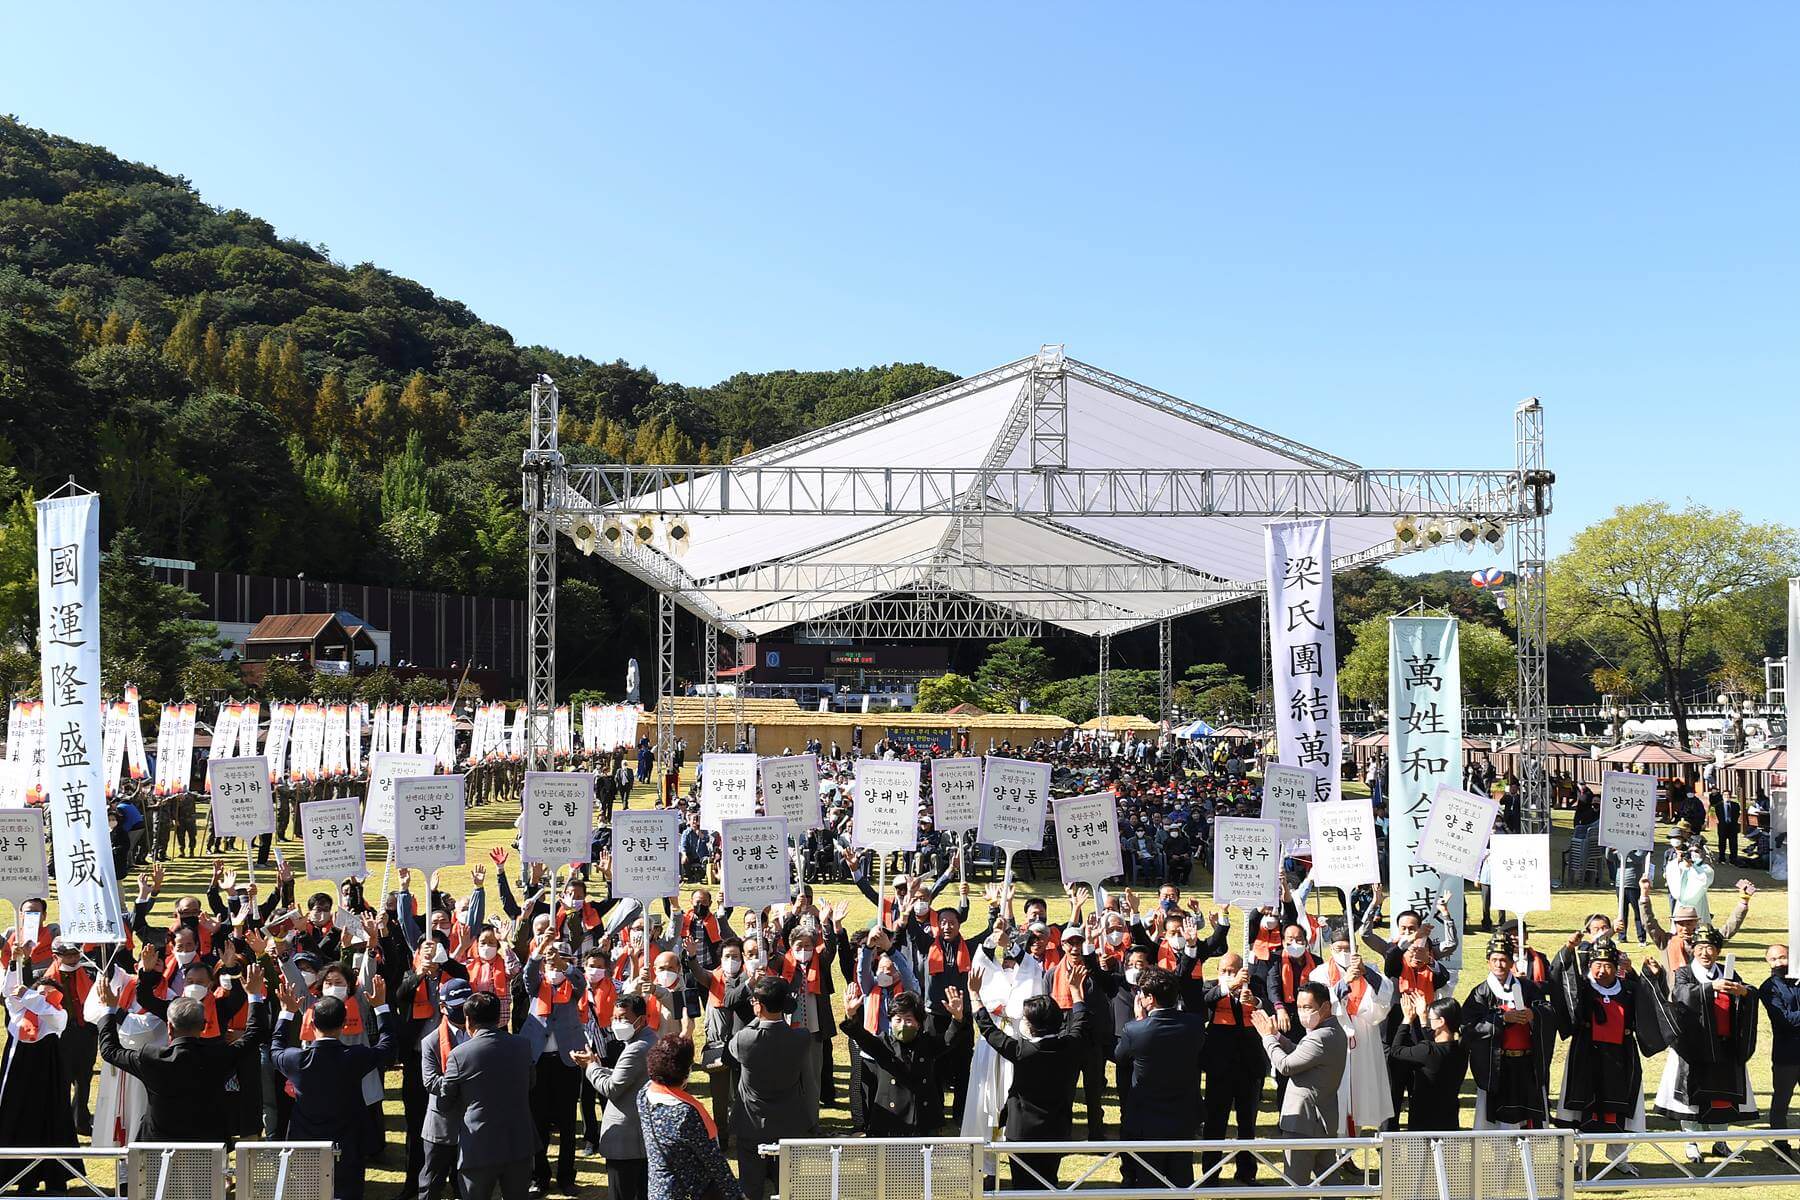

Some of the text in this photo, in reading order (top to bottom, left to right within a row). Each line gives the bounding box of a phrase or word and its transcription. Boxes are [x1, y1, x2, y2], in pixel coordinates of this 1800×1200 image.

[49, 543, 104, 888] 國運隆盛萬歲
[219, 781, 261, 797] 양기하
[712, 778, 746, 792] 양윤위
[770, 778, 810, 795] 양세봉
[940, 779, 975, 794] 양사귀
[999, 775, 1033, 786] 독립운동가
[863, 788, 909, 807] 양대박
[992, 786, 1037, 806] 양일동
[1611, 797, 1644, 811] 양지손
[413, 804, 444, 821] 양관
[311, 822, 353, 840] 양윤신
[1066, 820, 1108, 839] 양전백
[1322, 827, 1363, 842] 양여공
[621, 836, 669, 853] 양한묵
[732, 845, 779, 862] 양팽손
[1225, 845, 1269, 862] 양헌수
